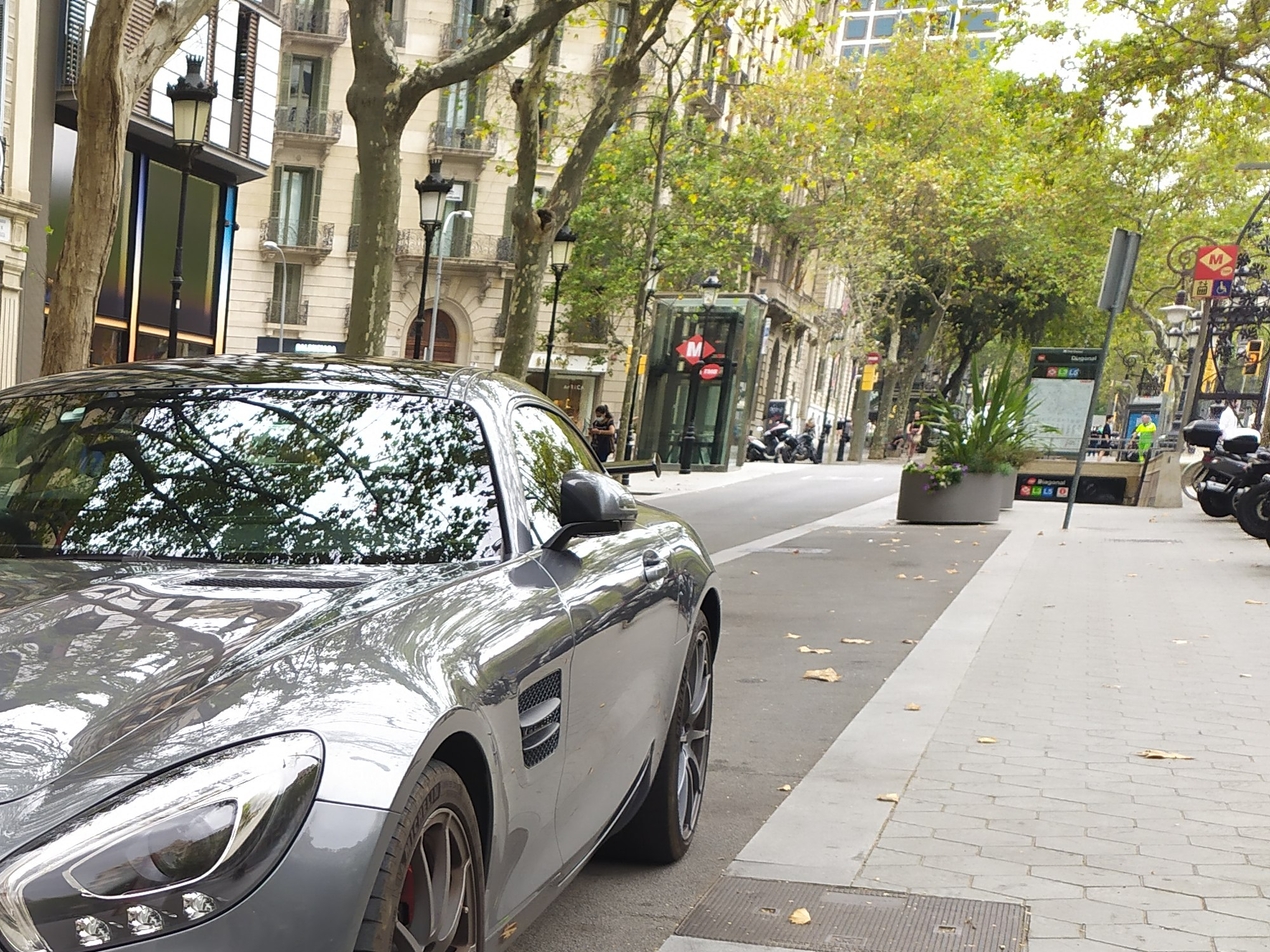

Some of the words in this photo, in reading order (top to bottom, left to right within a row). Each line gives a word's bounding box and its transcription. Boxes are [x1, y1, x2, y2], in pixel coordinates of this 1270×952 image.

[1209, 254, 1223, 265] M
[686, 341, 703, 357] M
[1070, 355, 1098, 363] Diagonal
[1037, 478, 1066, 486] Diagonal
